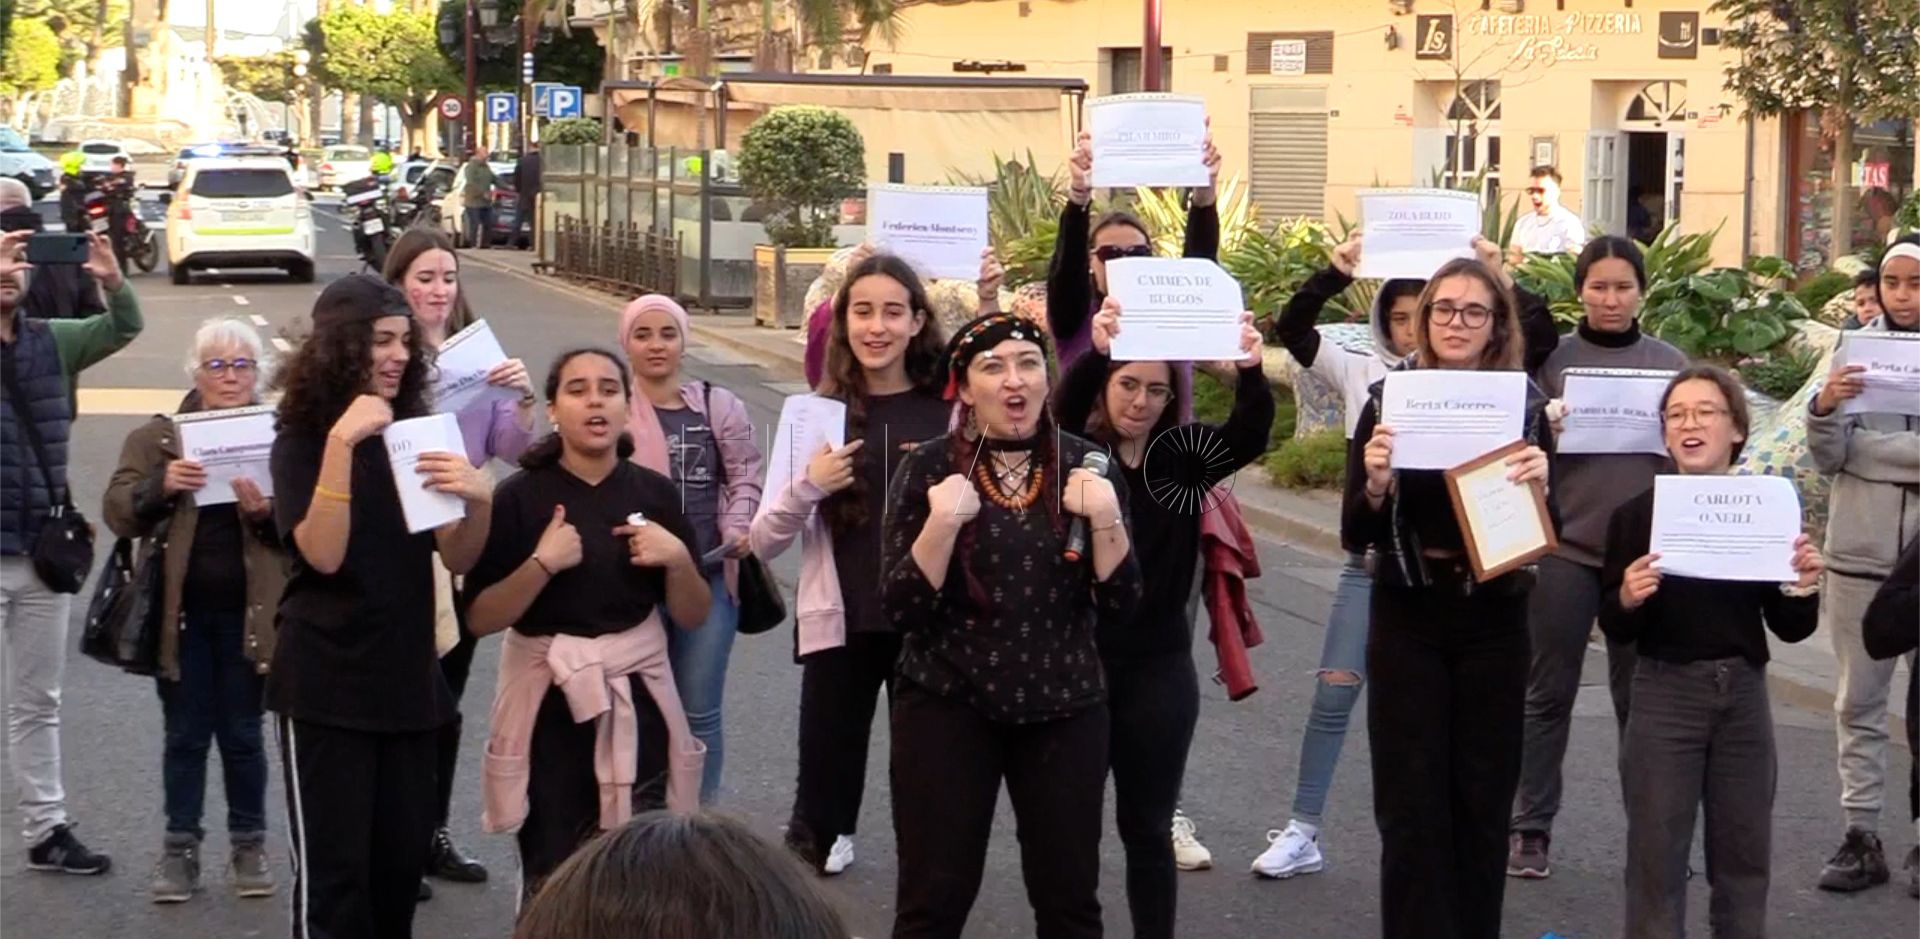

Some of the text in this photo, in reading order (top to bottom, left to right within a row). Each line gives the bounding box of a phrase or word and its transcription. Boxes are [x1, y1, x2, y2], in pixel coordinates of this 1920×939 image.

[1468, 11, 1643, 36] CAFETERIA PIZZERIA
[446, 103, 458, 113] 30
[492, 97, 511, 120] P
[553, 90, 574, 116] P
[1137, 273, 1213, 287] CARMEN DE
[1148, 293, 1204, 305] BURGOS
[1405, 399, 1441, 410] Berta
[1693, 493, 1763, 506] CARLOTA
